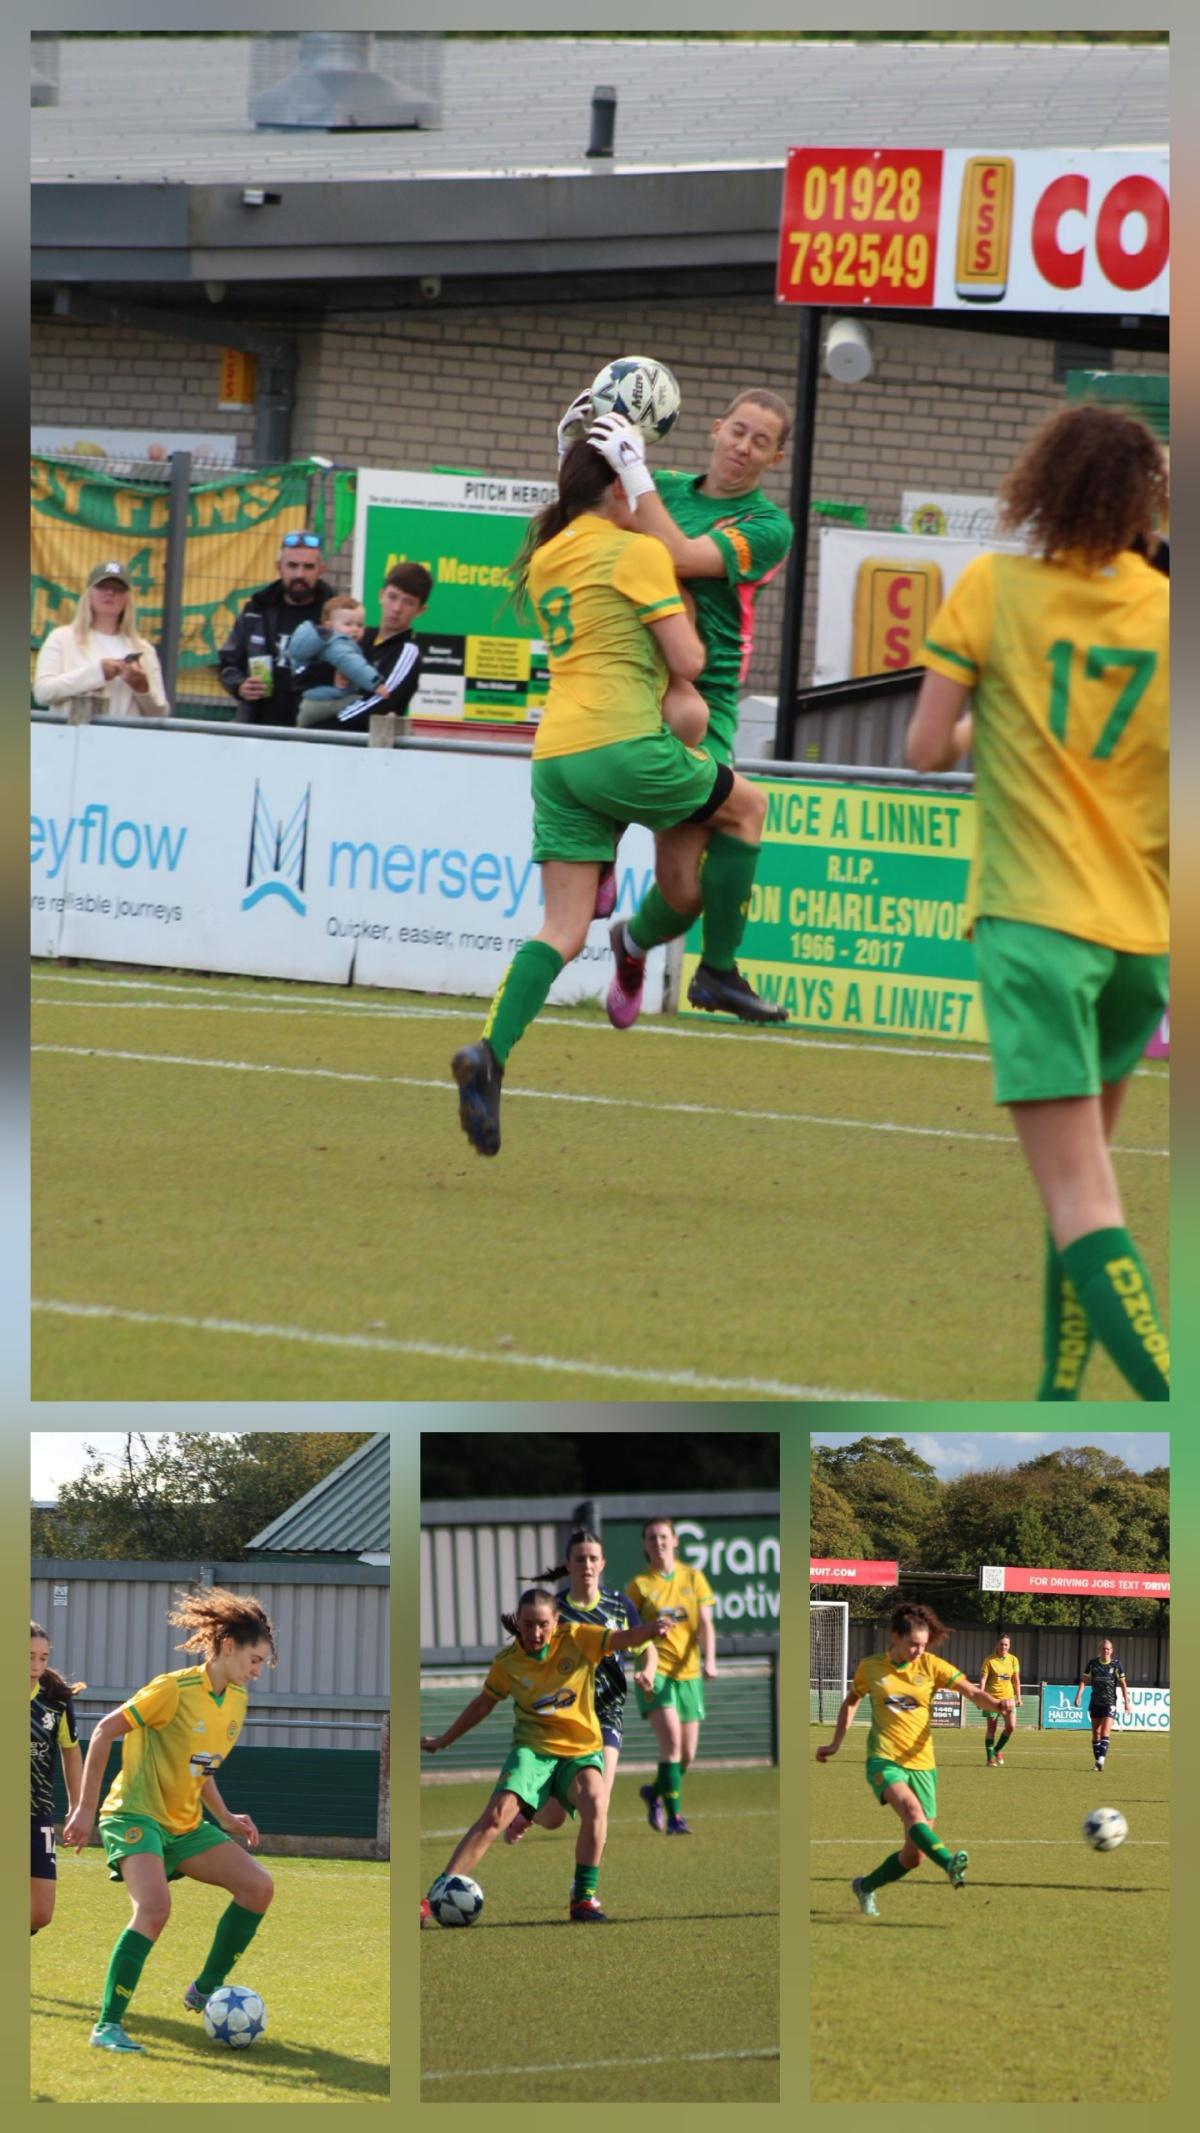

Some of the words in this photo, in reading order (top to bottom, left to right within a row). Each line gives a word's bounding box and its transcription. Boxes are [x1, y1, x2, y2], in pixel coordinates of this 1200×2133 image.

[803, 165, 921, 222] 01928
[789, 230, 929, 289] 732549
[1031, 173, 1170, 291] CO
[465, 481, 507, 502] PITCH
[512, 485, 559, 505] HEROE
[127, 548, 156, 596] 4
[540, 587, 575, 657] 8
[1043, 639, 1157, 760] 17
[766, 792, 821, 836] NCE
[830, 798, 849, 839] A
[860, 800, 961, 848] LINNET
[826, 855, 879, 885] R.I.P.
[326, 916, 392, 942] Quicker,
[399, 924, 454, 948] easier,
[459, 930, 503, 951] more
[746, 884, 781, 924] ON
[788, 887, 971, 940] CHARLESWOR
[791, 932, 835, 960] 1966
[854, 938, 905, 968] 2017
[754, 973, 833, 1020] WAYS
[843, 982, 862, 1023] A
[874, 985, 973, 1034] LINNET
[675, 1521, 780, 1576] Gran
[1029, 1576, 1048, 1586] FOR
[1050, 1577, 1089, 1587] DRIVING
[1091, 1579, 1116, 1589] JOBS
[1118, 1580, 1139, 1590] TEXT
[1048, 1710, 1083, 1720] HALTON
